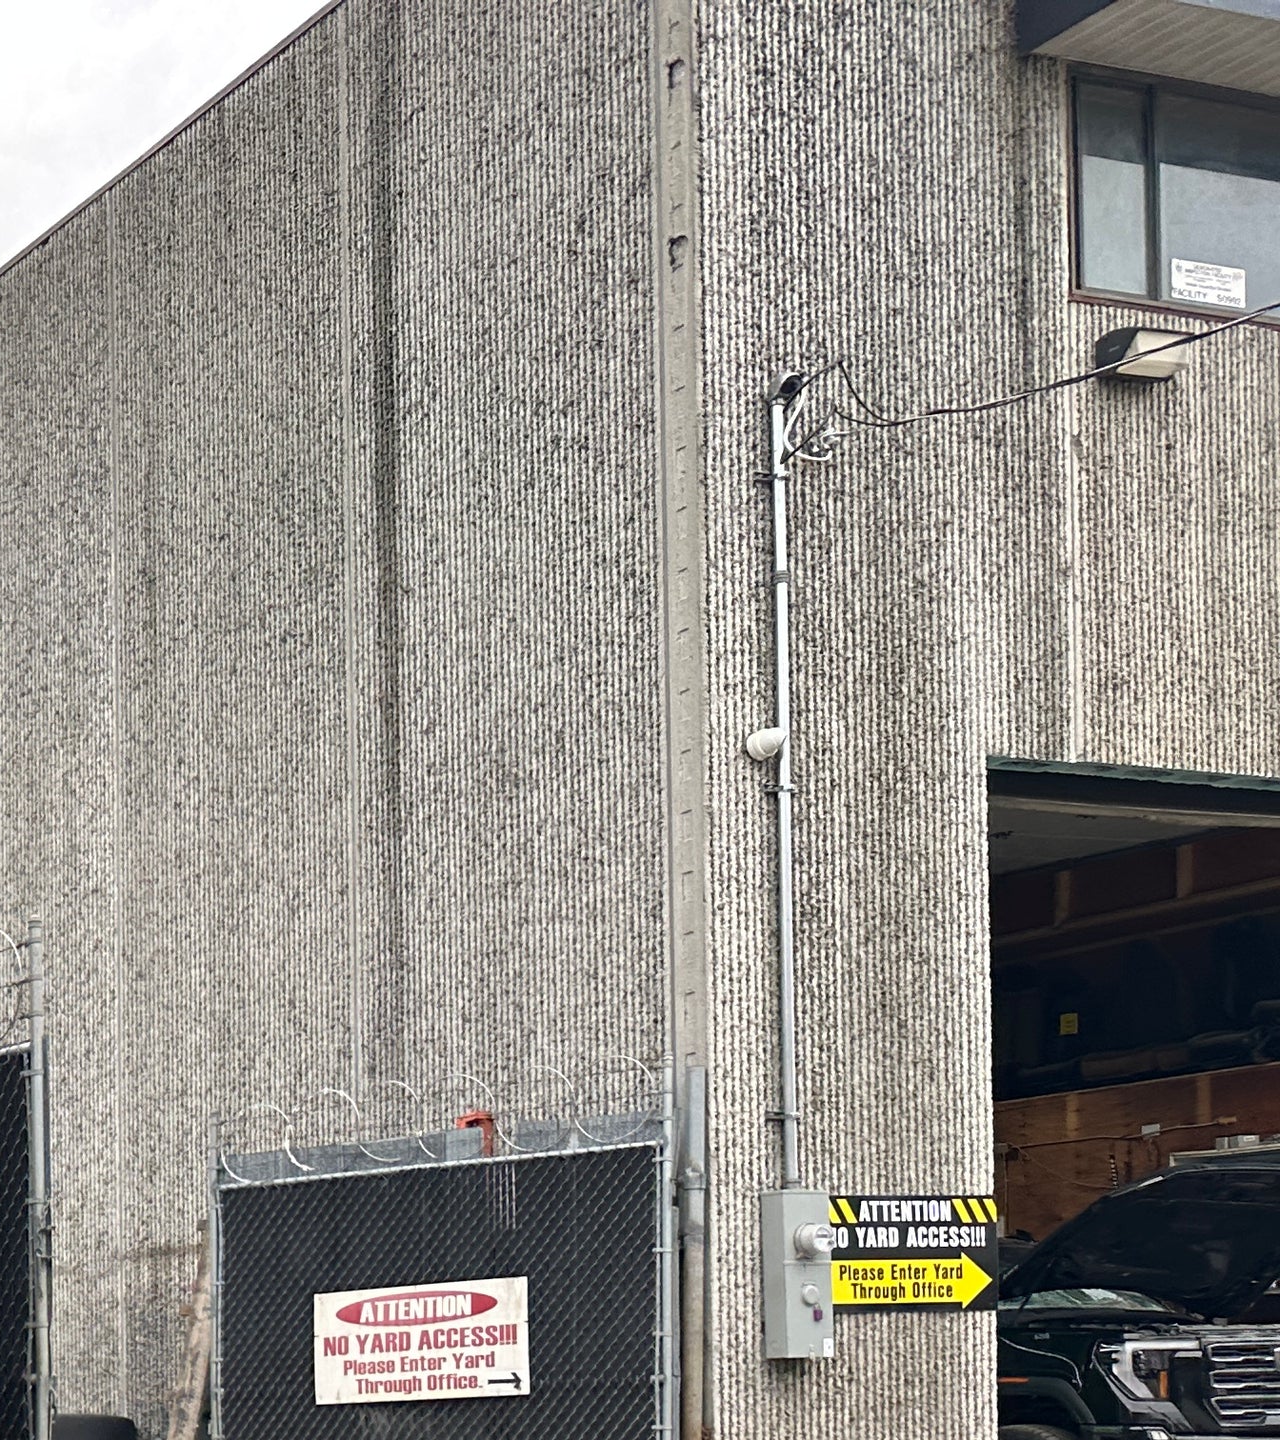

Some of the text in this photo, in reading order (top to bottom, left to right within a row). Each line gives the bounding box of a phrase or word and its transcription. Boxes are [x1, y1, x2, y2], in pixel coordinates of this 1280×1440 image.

[858, 1199, 952, 1222] ATTENTION
[855, 1226, 899, 1249] YARD
[906, 1225, 987, 1248] ACCESS!!!
[839, 1263, 964, 1282] Please Enter Yard
[851, 1282, 954, 1302] Through Office
[358, 1294, 472, 1324] ATTENTION
[323, 1324, 518, 1357] NO YARD ACCESS!!!
[343, 1351, 496, 1376] Please Enter Yard
[355, 1376, 422, 1395] Through
